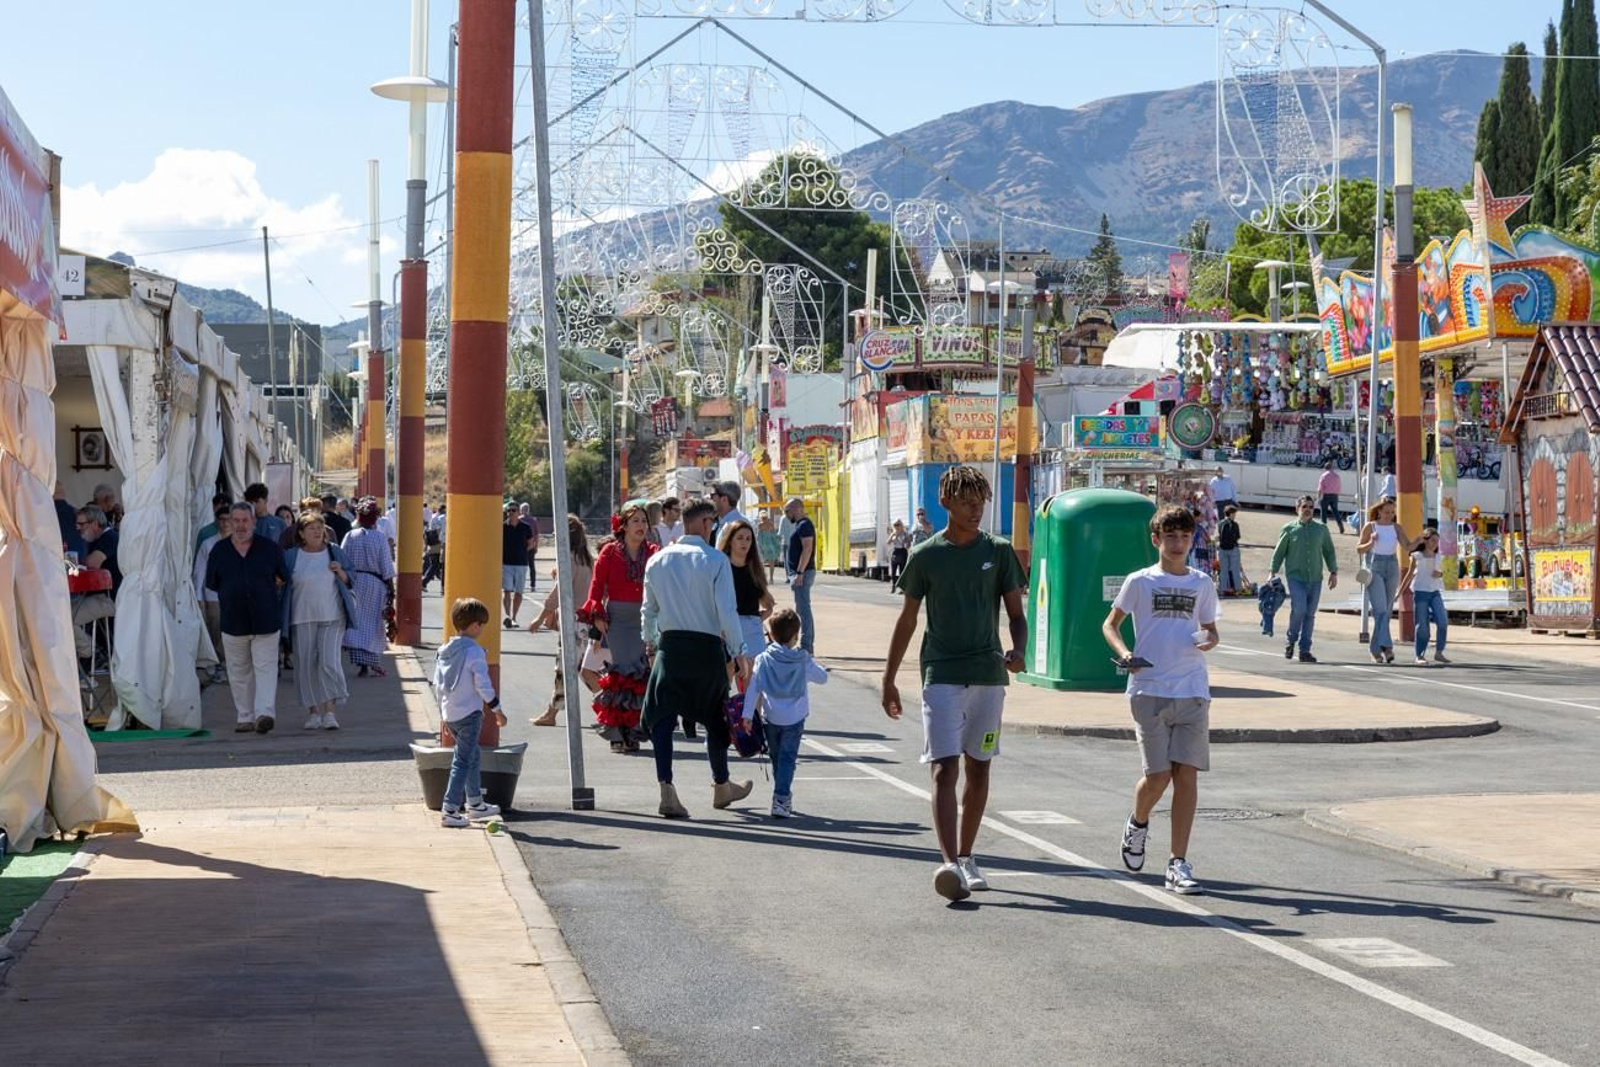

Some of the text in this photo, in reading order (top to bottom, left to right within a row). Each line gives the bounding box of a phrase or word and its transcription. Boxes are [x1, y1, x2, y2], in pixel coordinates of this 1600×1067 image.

[62, 268, 80, 283] 42
[865, 339, 891, 349] CRUZ
[932, 335, 980, 353] VINOS
[863, 346, 897, 358] BLANCA
[1080, 419, 1126, 431] BEBIDAS
[954, 427, 963, 440] Y
[1101, 432, 1152, 445] JUGUETES
[1541, 554, 1584, 578] Buñuelos
